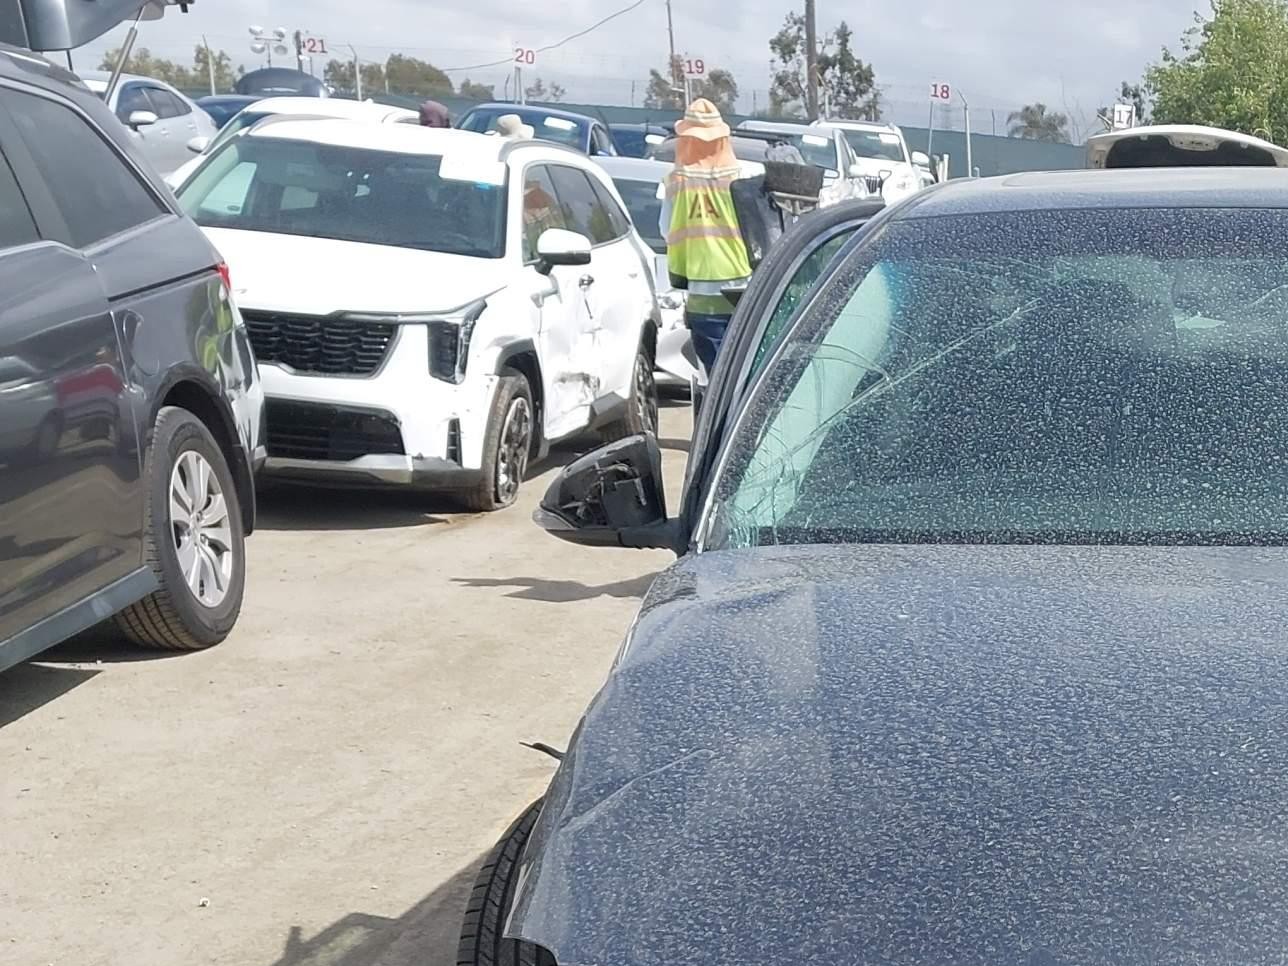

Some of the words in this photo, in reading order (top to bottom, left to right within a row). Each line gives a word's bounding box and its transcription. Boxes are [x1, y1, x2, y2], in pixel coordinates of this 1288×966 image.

[306, 38, 328, 54] 21
[514, 48, 535, 64] 20
[686, 59, 705, 74] 19
[930, 83, 950, 99] 18
[1115, 110, 1132, 125] 17
